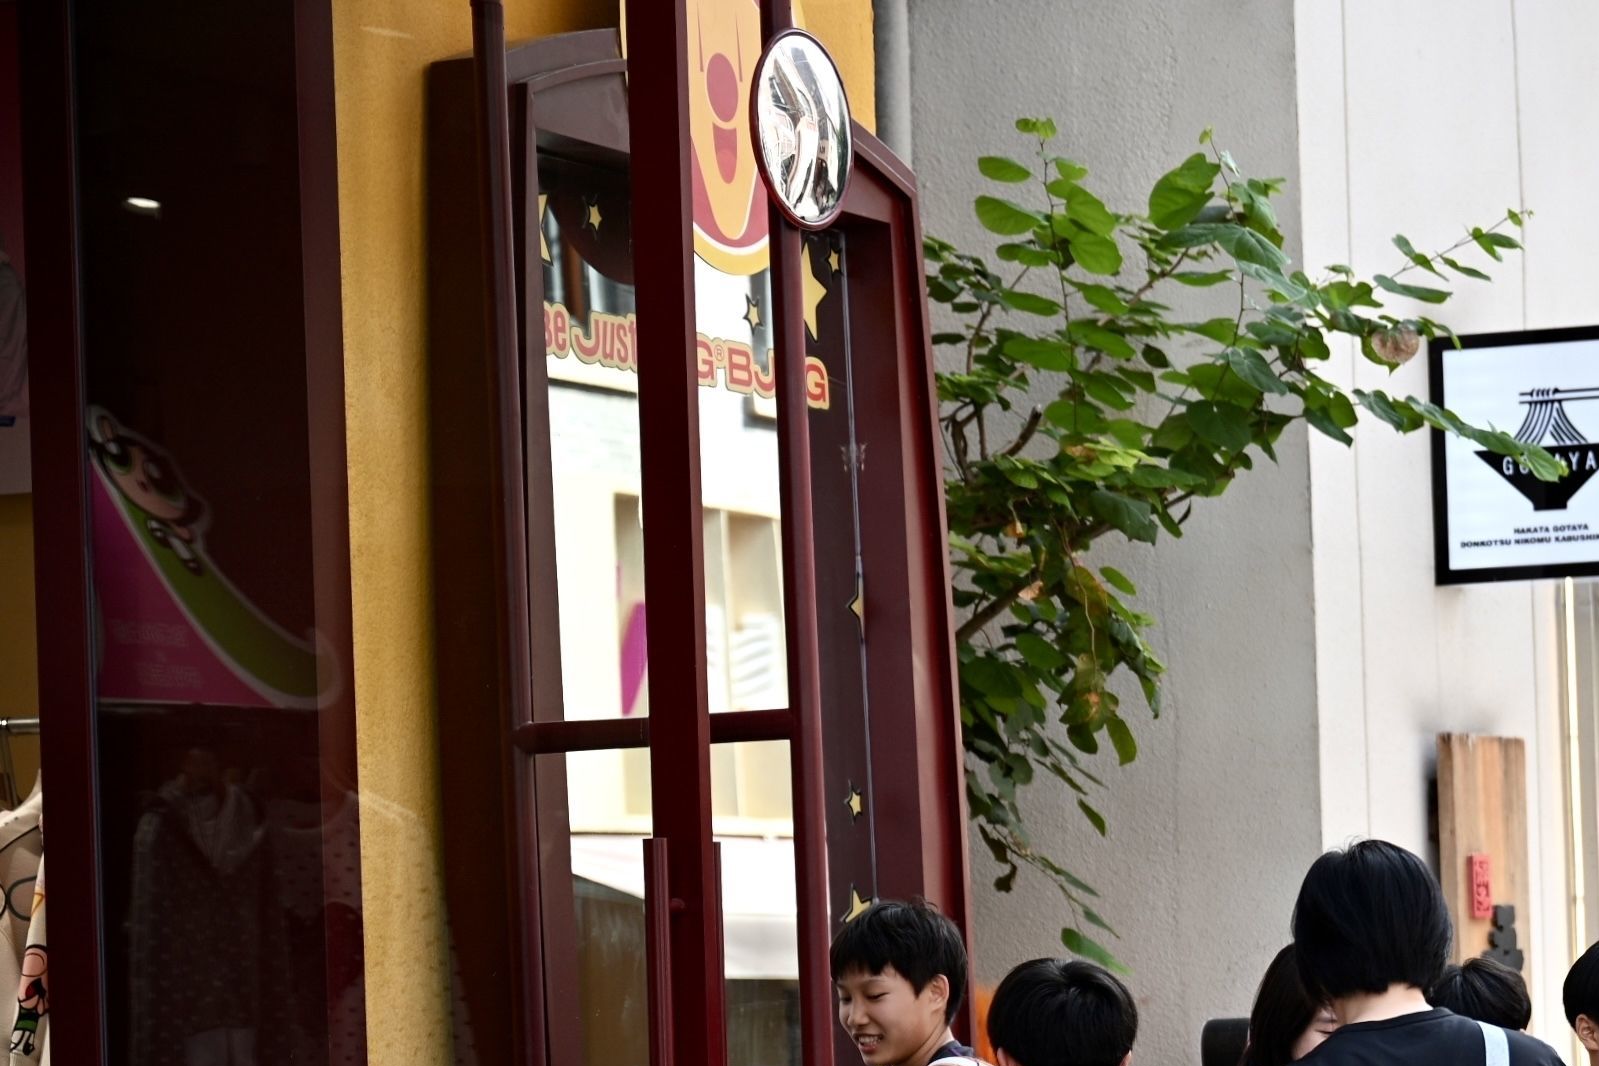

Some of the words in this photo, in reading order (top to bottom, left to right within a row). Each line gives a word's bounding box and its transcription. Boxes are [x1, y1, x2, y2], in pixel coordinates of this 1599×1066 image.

[1513, 525, 1550, 535] HAKATA
[1552, 523, 1589, 533] GOTAYA
[1514, 536, 1551, 546] NIKOMU
